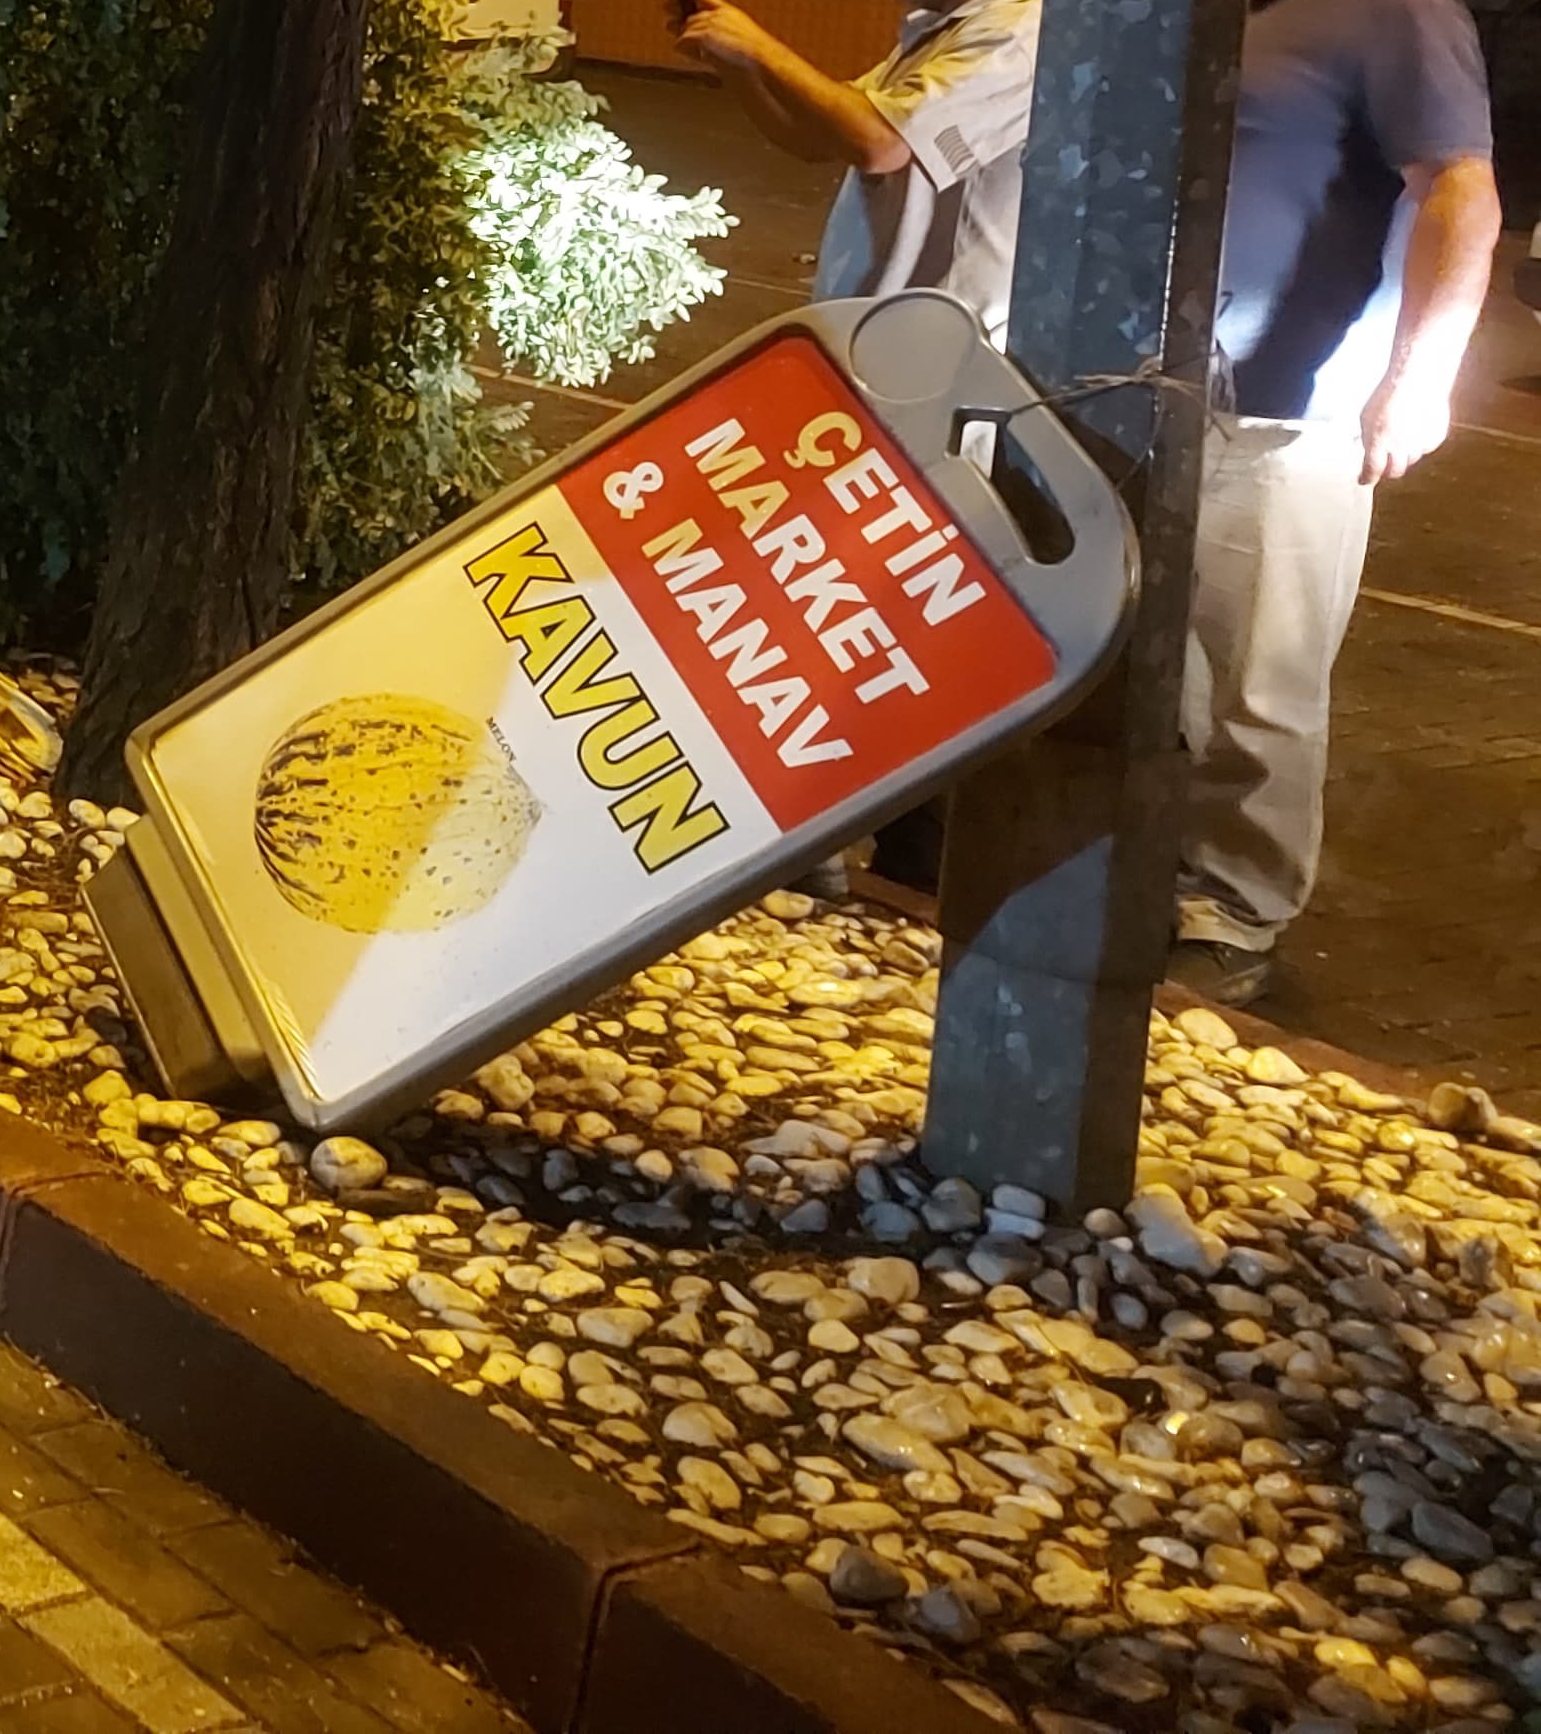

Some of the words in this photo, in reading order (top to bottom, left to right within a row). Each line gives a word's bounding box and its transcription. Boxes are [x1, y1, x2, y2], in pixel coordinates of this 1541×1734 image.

[602, 461, 664, 520] &
[641, 518, 854, 768] MANAV
[684, 418, 930, 705] MARKET
[783, 411, 986, 627] ÇETİN
[463, 522, 729, 874] KAVUN
